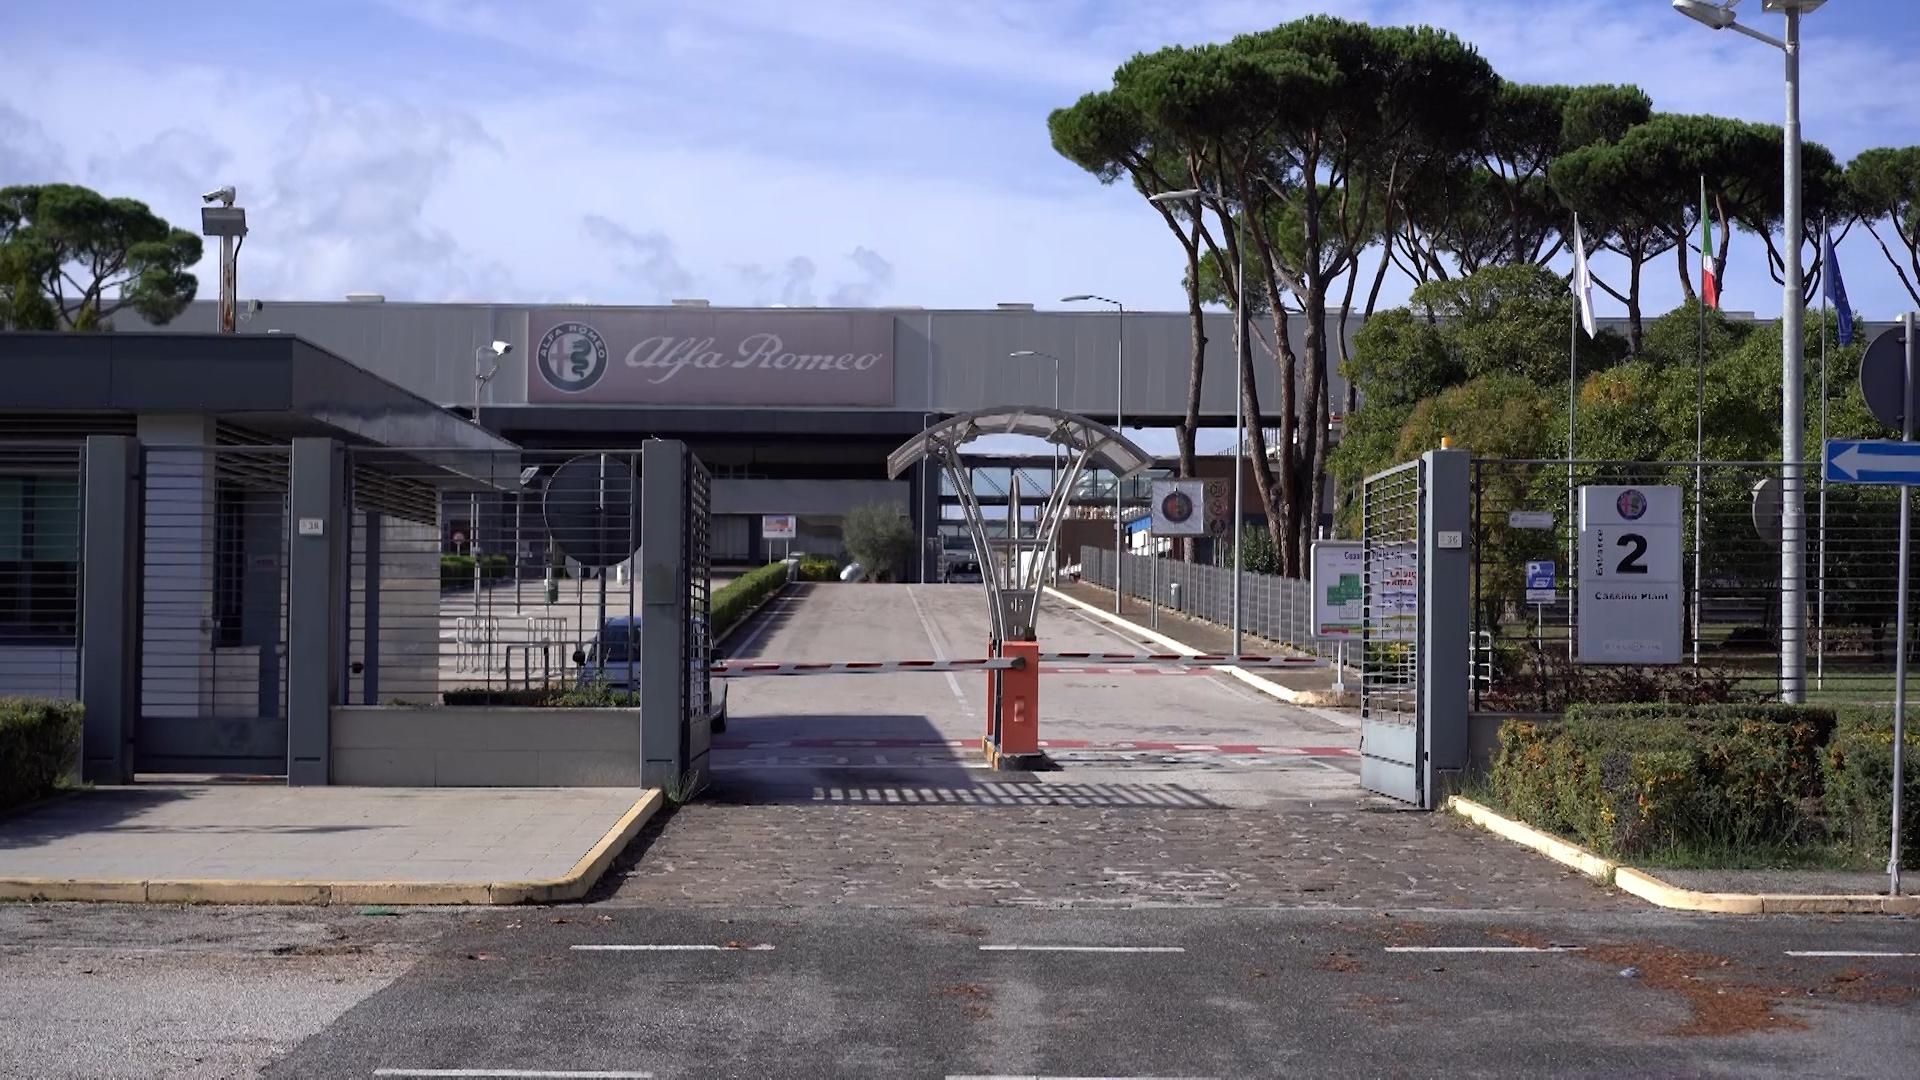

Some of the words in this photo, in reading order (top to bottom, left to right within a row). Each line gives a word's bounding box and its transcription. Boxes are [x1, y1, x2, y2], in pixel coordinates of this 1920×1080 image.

[540, 328, 563, 357] ALFA
[568, 325, 605, 358] ROMEO
[625, 335, 730, 384] Alfa
[732, 332, 883, 371] Romeo
[1528, 563, 1540, 578] P
[1596, 529, 1604, 576] Entrance
[1616, 533, 1648, 574] 2
[1595, 591, 1638, 600] Cassino
[1641, 592, 1669, 600] Plant
